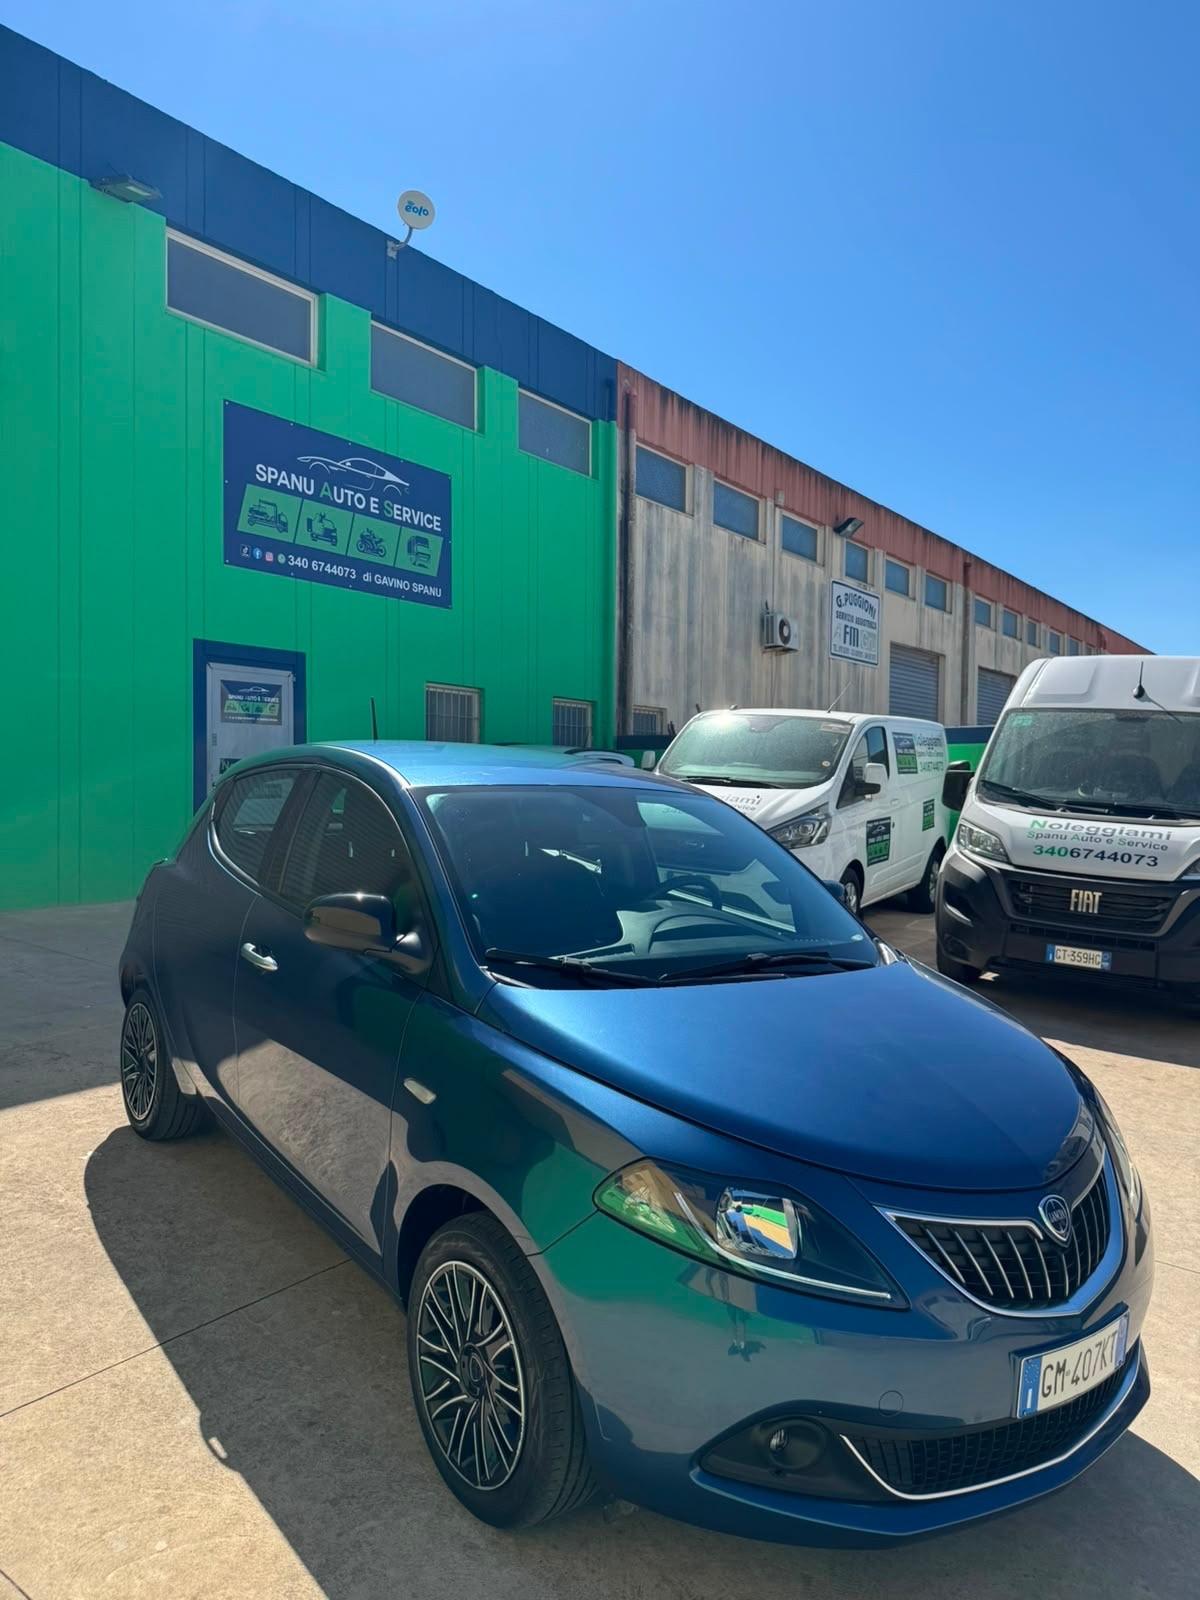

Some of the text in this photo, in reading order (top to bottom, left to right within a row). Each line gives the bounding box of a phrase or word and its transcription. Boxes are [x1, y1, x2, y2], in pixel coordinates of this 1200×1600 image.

[255, 463, 442, 532] SPANU AUTO E SERVICE
[287, 554, 442, 598] 340 6744073 di GAVINO SPANU
[1026, 831, 1067, 841] Spanu
[1071, 833, 1101, 843] Auto
[1118, 838, 1168, 851] Service
[1030, 819, 1172, 841] Noleggiami
[1033, 844, 1158, 867] 3406744073
[1069, 889, 1103, 914] FIAT
